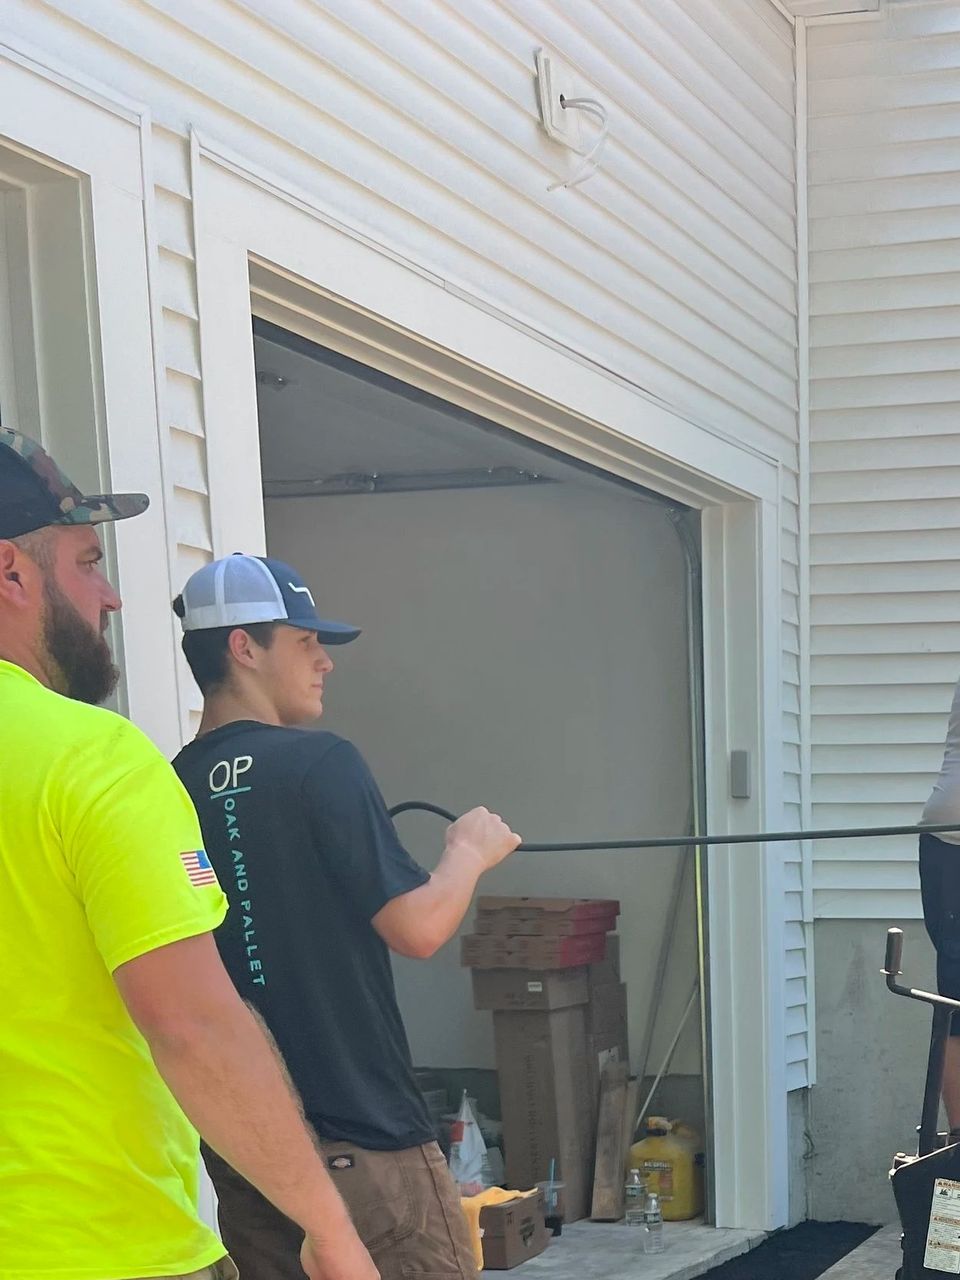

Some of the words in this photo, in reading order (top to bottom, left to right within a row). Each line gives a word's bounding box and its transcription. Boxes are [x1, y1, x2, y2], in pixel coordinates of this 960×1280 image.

[209, 755, 253, 792] OP
[224, 798, 241, 841] OAK
[231, 850, 249, 891] AND
[241, 900, 266, 985] PALLET
